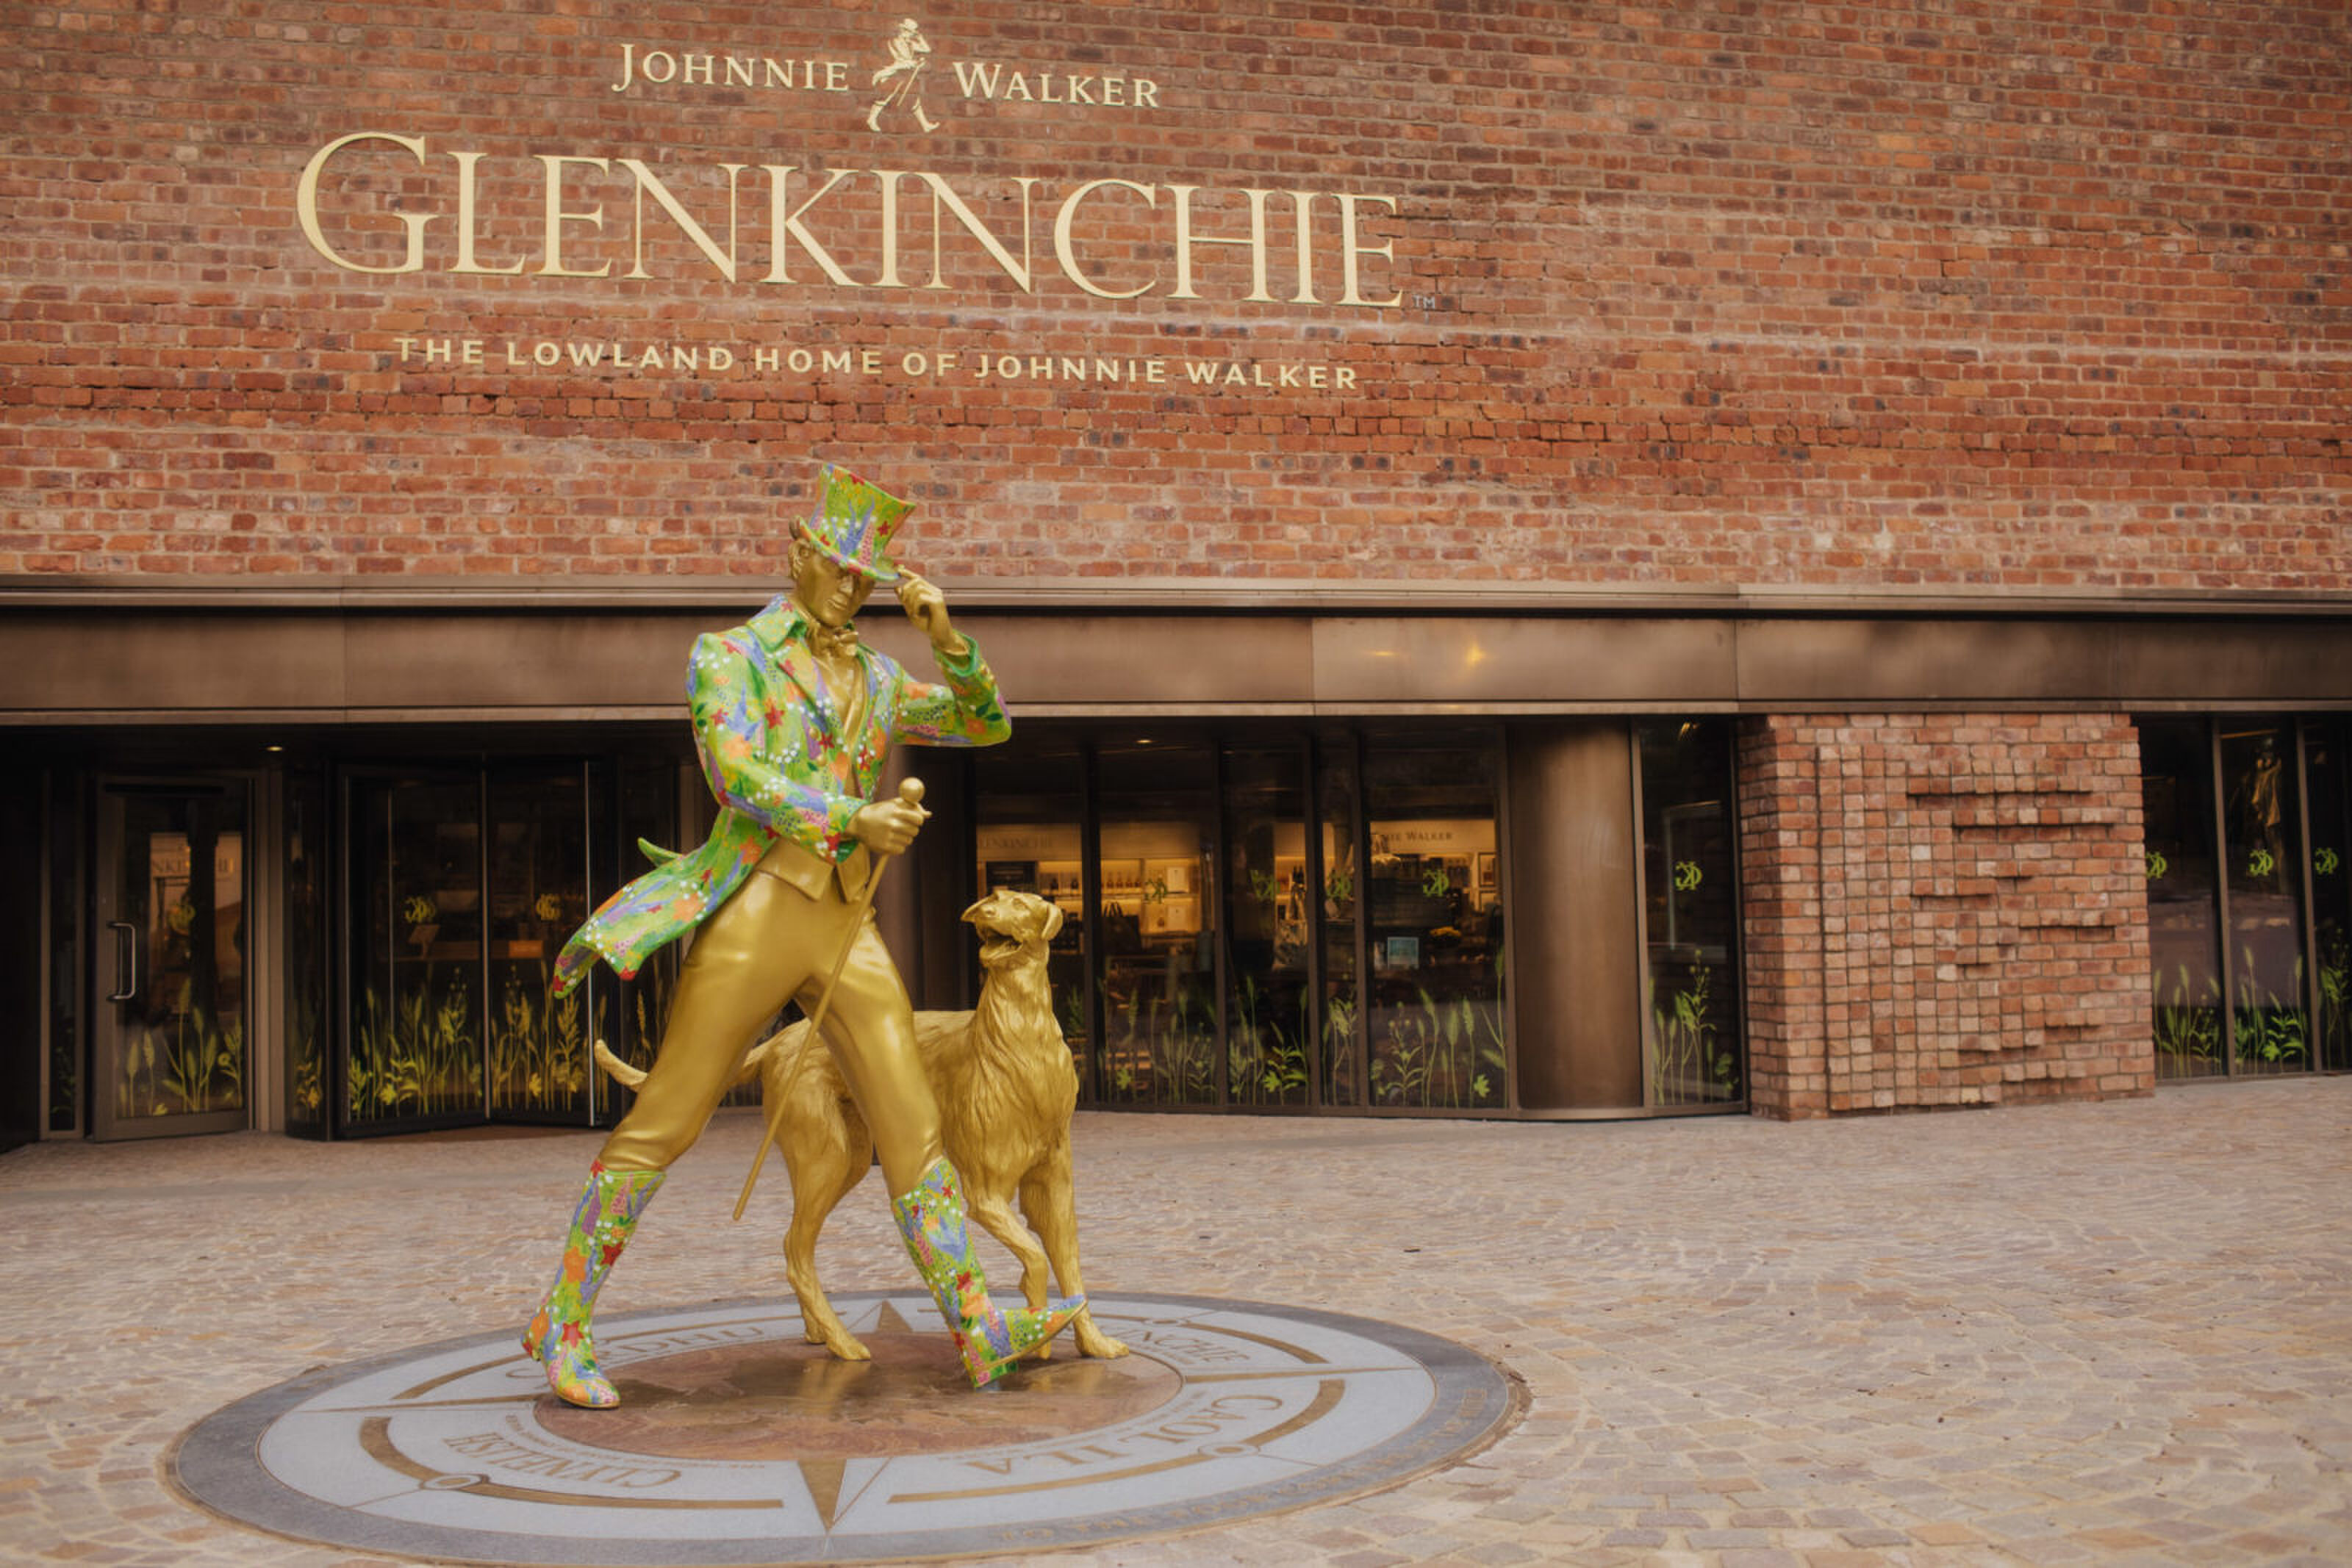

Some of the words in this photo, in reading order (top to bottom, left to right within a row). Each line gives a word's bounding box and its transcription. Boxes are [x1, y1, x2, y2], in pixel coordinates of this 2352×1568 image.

[611, 43, 849, 92] JOHNNIE
[952, 61, 1159, 108] WALKER
[296, 131, 1402, 308] GLENKINCHIE
[393, 337, 484, 364] THE
[506, 341, 734, 371] LOWLAND
[755, 348, 883, 375] HOME
[902, 352, 956, 377] OF
[974, 354, 1166, 384] JOHNNIE
[1185, 362, 1356, 389] WALKER
[1117, 1395, 1283, 1445] CAOL
[442, 1431, 682, 1489] CLYNELISH
[964, 1444, 1132, 1475] ILA
